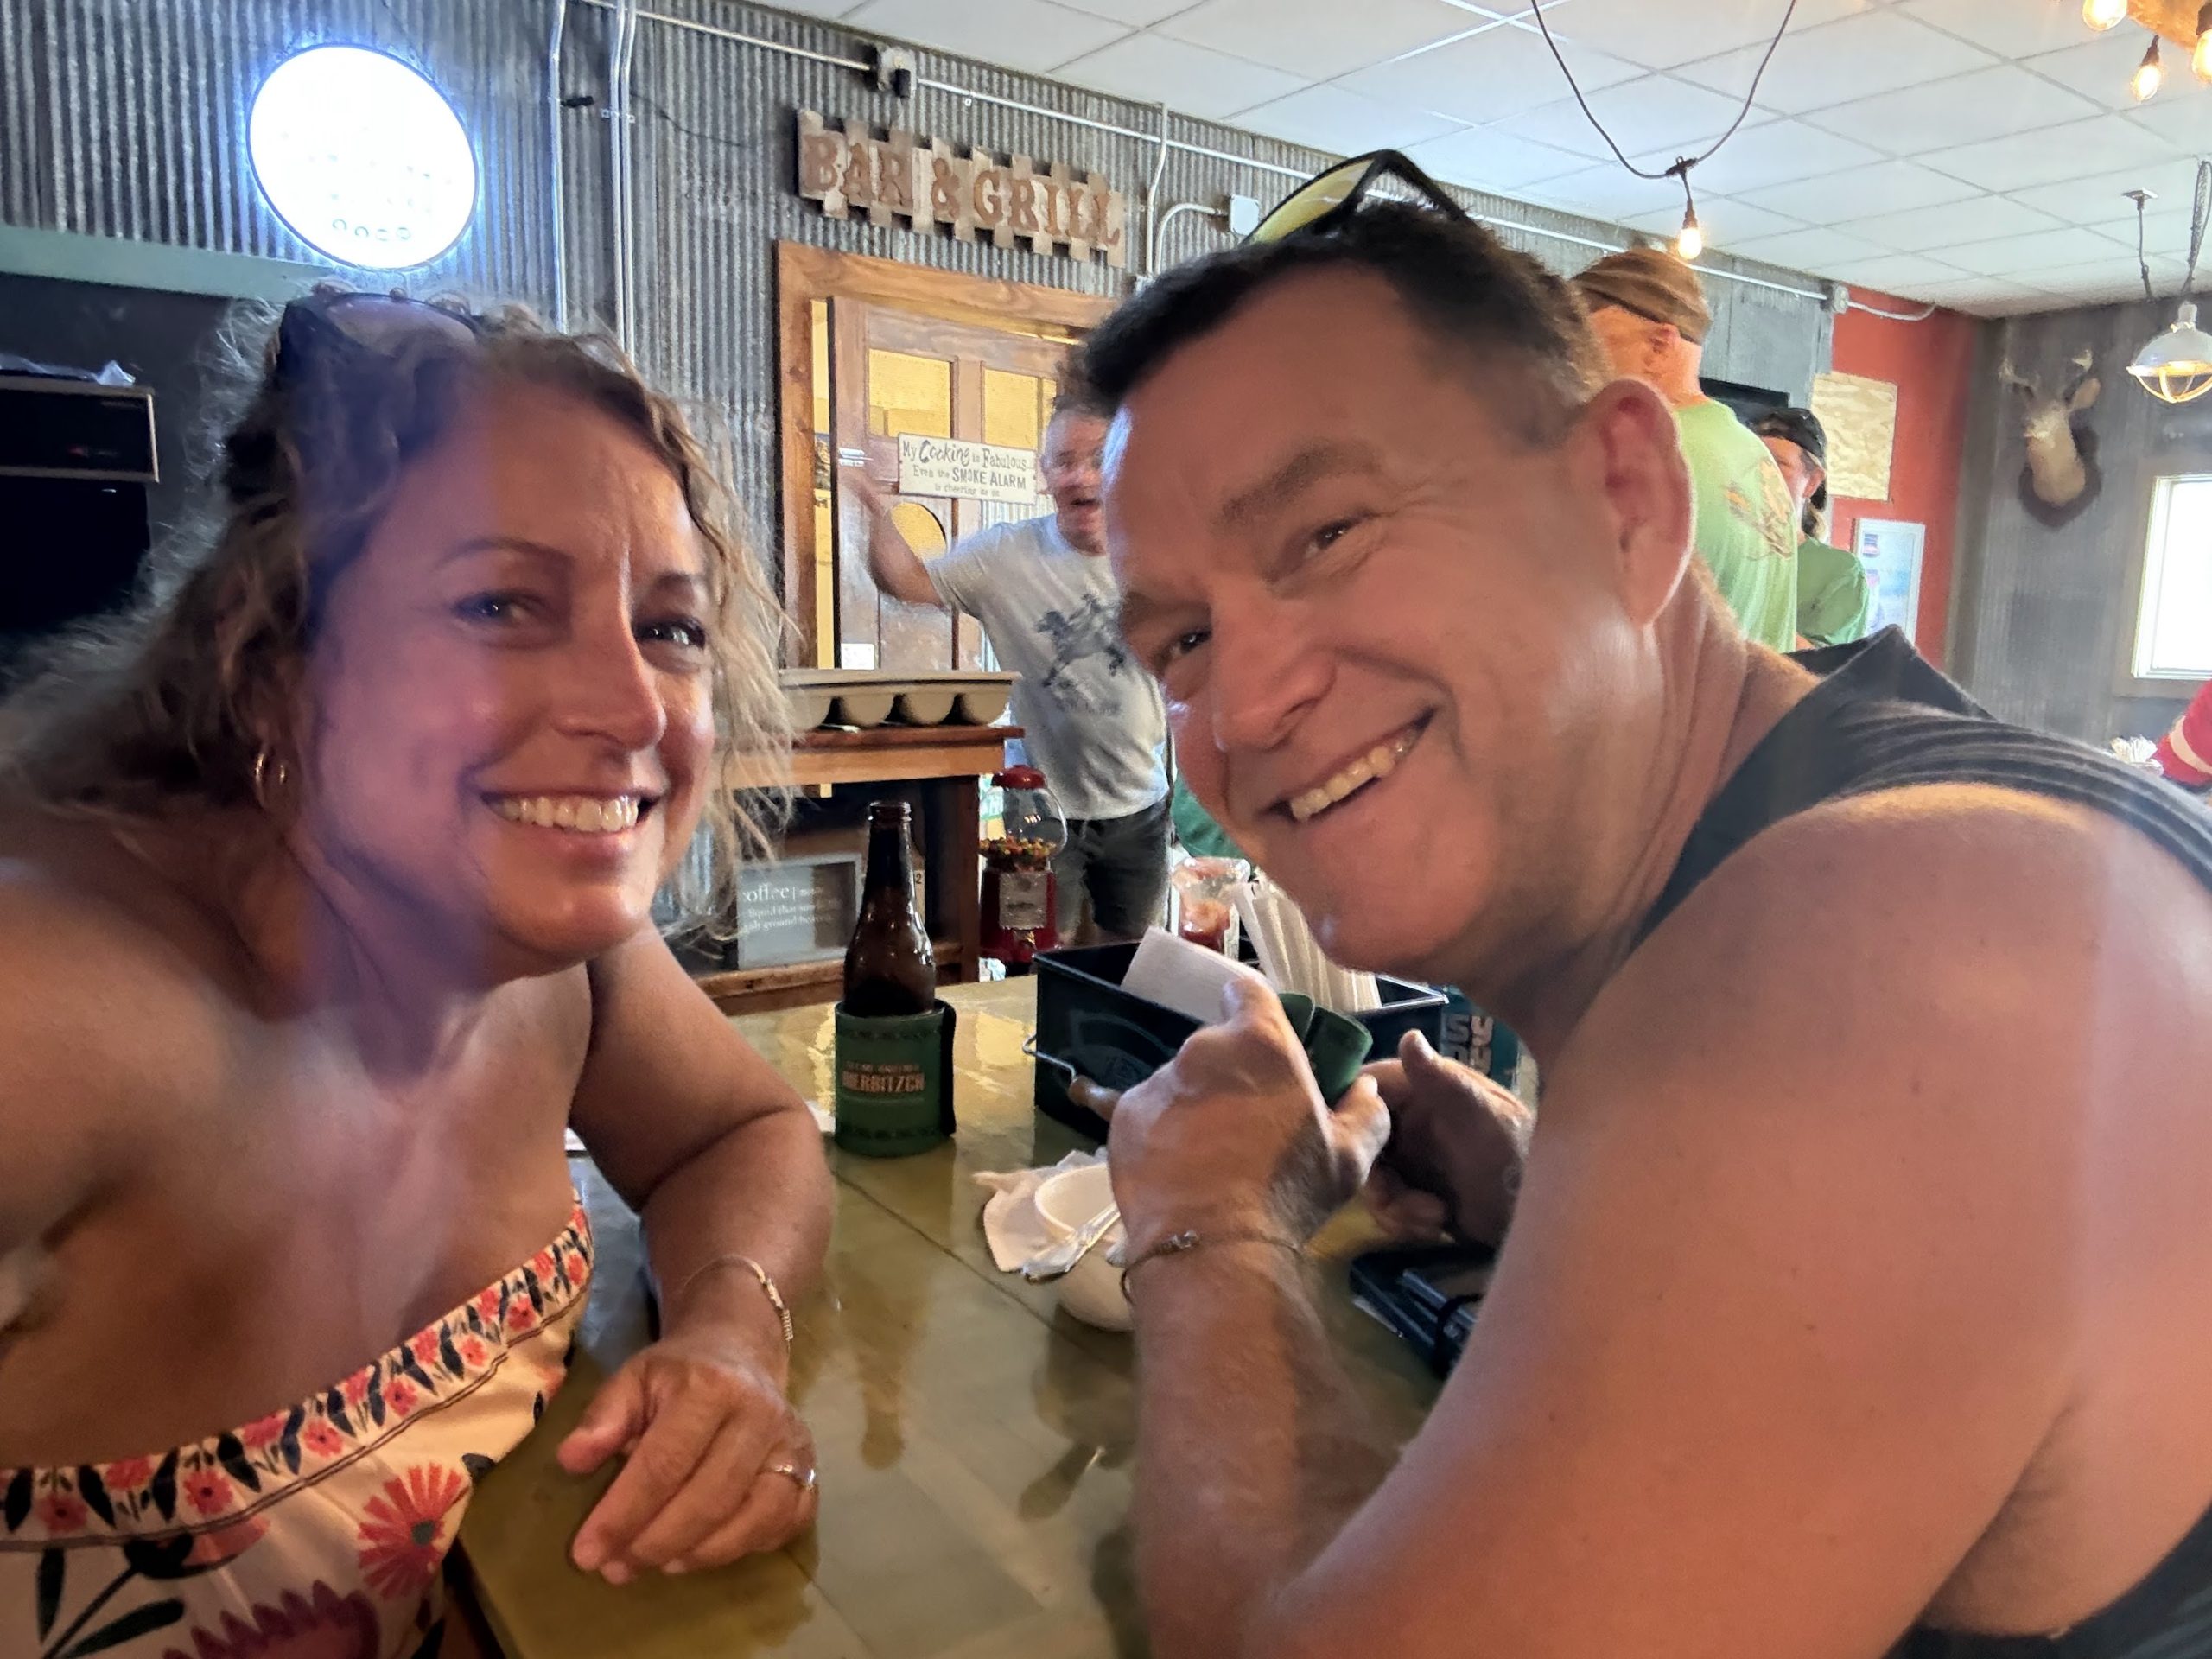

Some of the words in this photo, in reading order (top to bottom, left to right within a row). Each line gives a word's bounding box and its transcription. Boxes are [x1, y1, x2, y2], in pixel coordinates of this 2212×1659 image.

[803, 134, 912, 207] BAR
[931, 156, 960, 219] &
[973, 168, 1122, 246] GRILL
[902, 440, 917, 461] My
[918, 439, 970, 467] Cooking
[912, 464, 934, 478] Even
[952, 467, 988, 485] SMOKE
[989, 471, 1027, 490] ALARM
